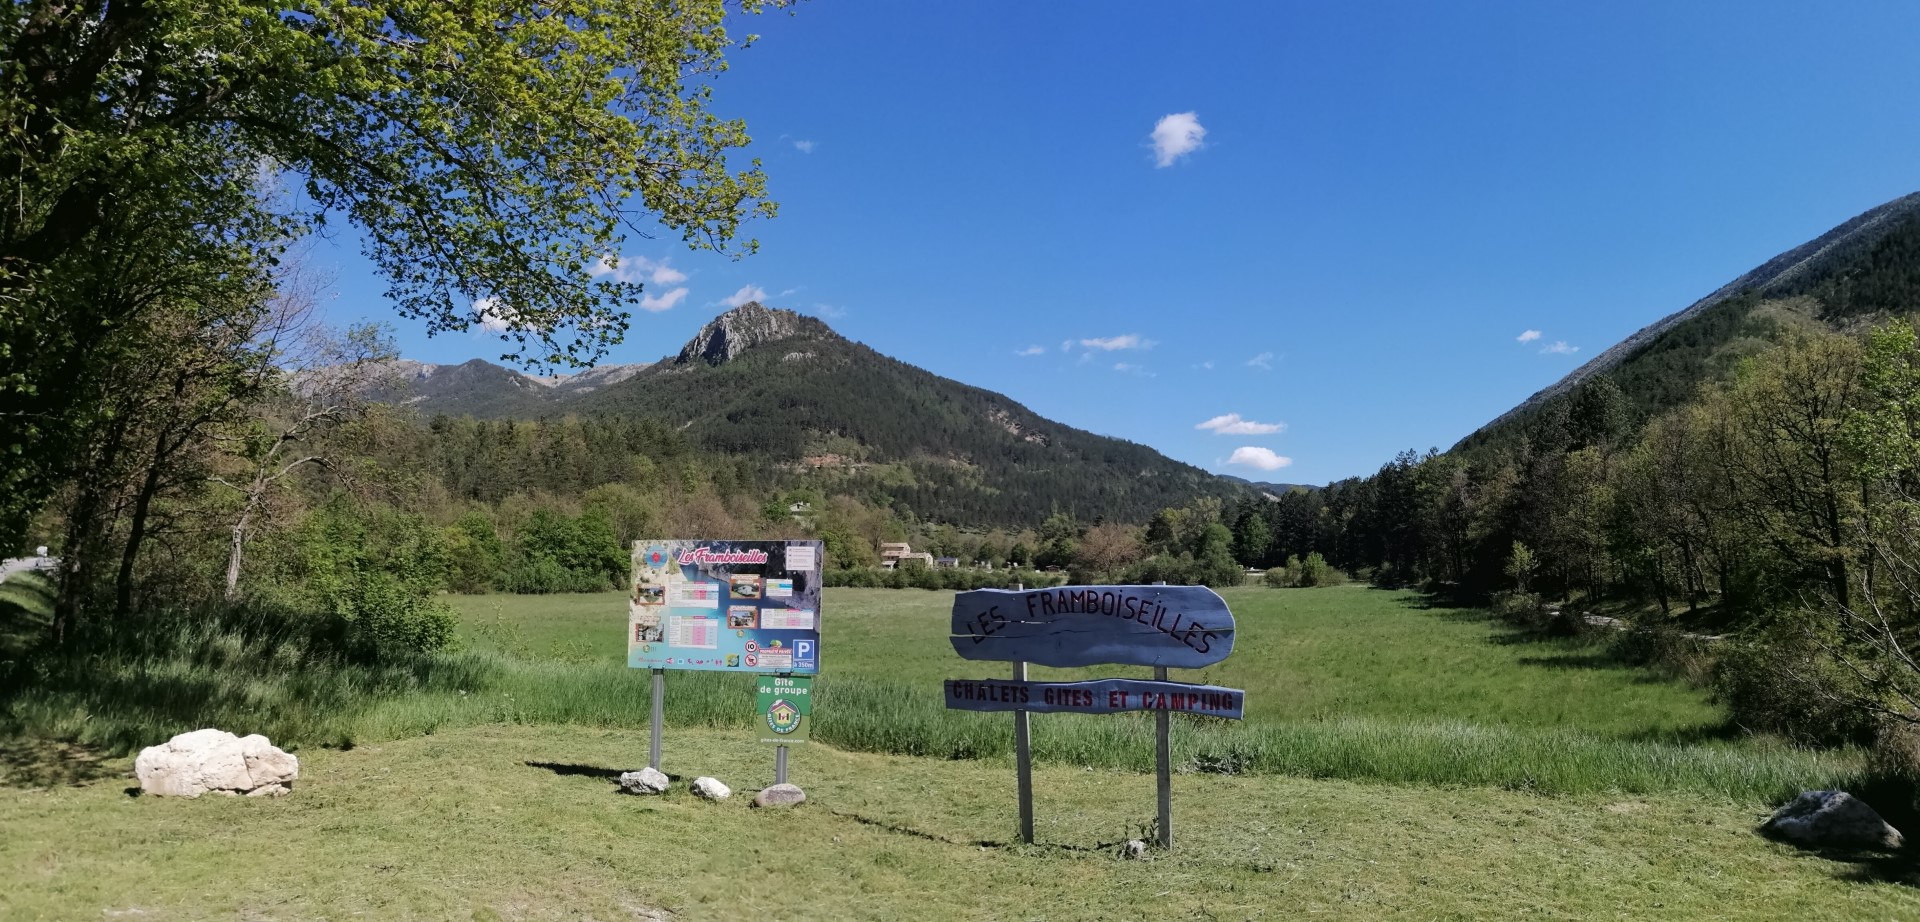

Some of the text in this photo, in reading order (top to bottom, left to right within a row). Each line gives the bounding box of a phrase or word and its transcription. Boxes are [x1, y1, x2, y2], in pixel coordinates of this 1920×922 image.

[677, 547, 768, 565] Les Framboiseilles
[967, 605, 1006, 645] LES
[798, 642, 810, 658] P
[774, 677, 794, 687] Gîte
[760, 686, 808, 696] de groupe
[953, 681, 1233, 711] CHALETS GITES ET CAMPING
